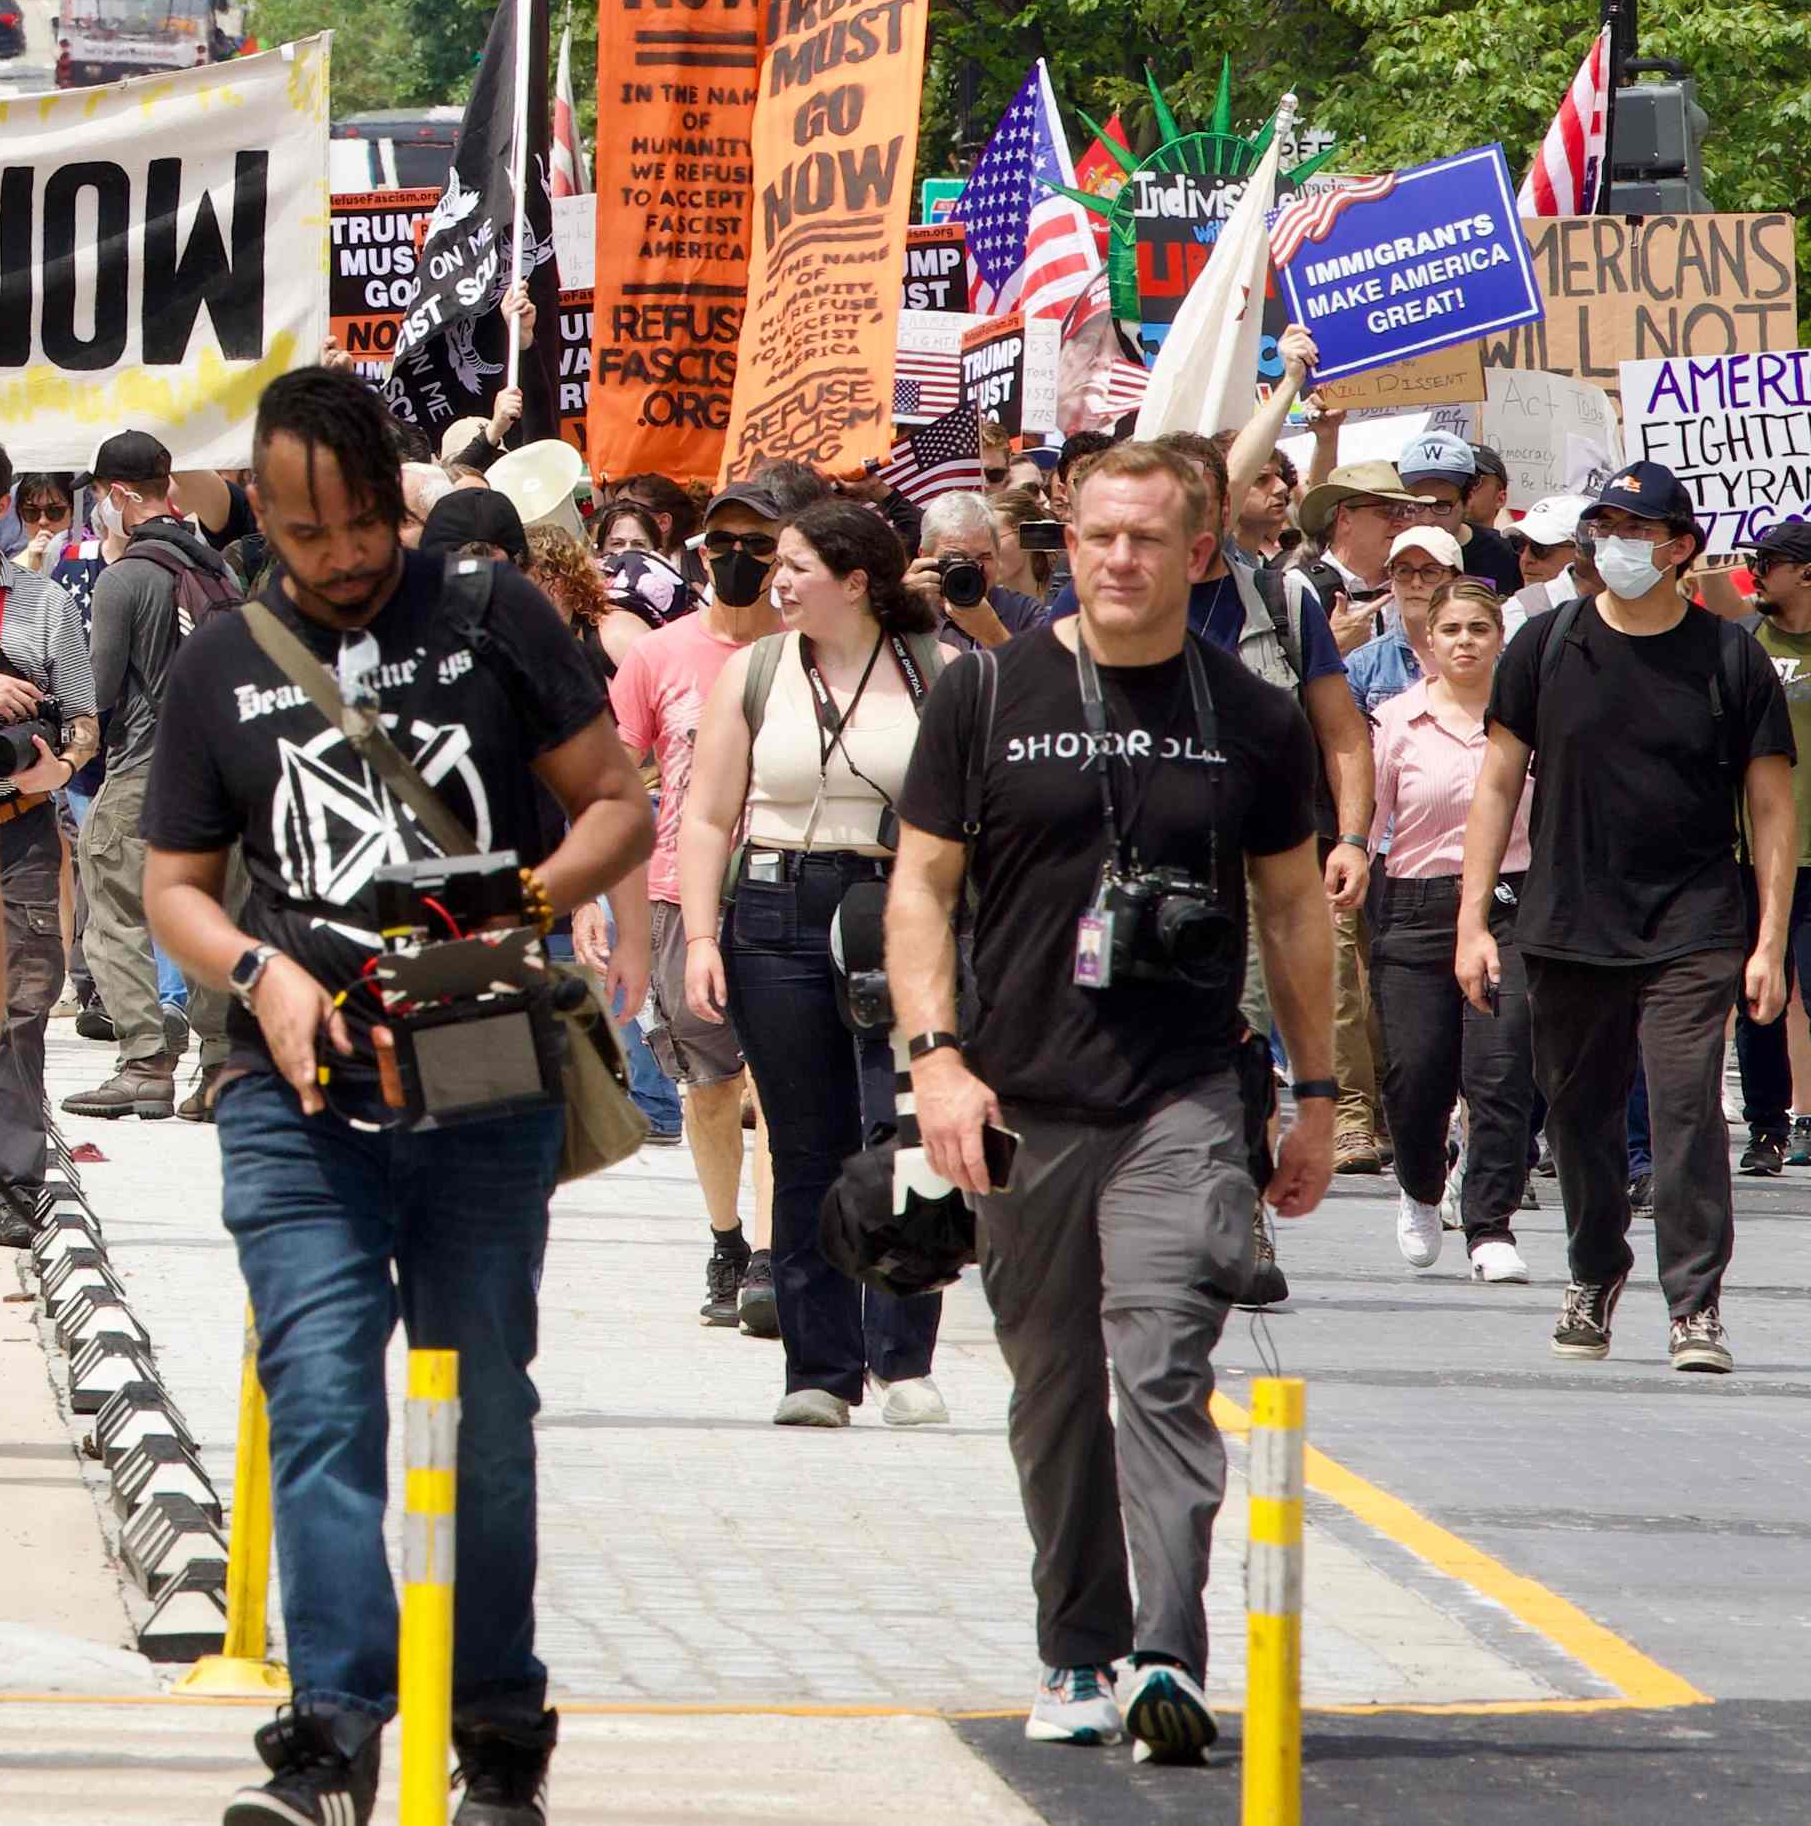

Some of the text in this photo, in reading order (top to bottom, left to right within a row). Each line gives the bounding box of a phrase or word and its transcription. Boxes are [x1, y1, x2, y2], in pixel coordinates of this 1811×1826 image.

[621, 83, 700, 104] IN THE
[683, 112, 712, 131] OF
[794, 83, 864, 147] GO
[630, 162, 666, 182] WE
[621, 188, 748, 209] TO ACCEPT
[763, 135, 904, 253] NOW
[645, 214, 742, 235] FASCIST
[429, 217, 495, 280] ON ME
[639, 239, 745, 262] AMERICA
[822, 244, 890, 265] NAME
[1305, 213, 1495, 287] IMMIGRANTS
[796, 268, 827, 286] OF
[1306, 242, 1512, 320] MAKE AMERICA
[612, 305, 745, 346] REFUS
[1366, 286, 1466, 334] GREAT!
[1636, 303, 1792, 361] NOT
[599, 348, 738, 388] FASCIS
[962, 337, 1022, 383] TRUMP
[419, 380, 455, 423] ME
[1377, 372, 1469, 397] DISSENT
[1500, 377, 1561, 420] Act
[637, 389, 731, 430] .ORG
[739, 379, 876, 457] REFUSE
[1423, 445, 1443, 462] W
[901, 658, 925, 699] DIGITAL
